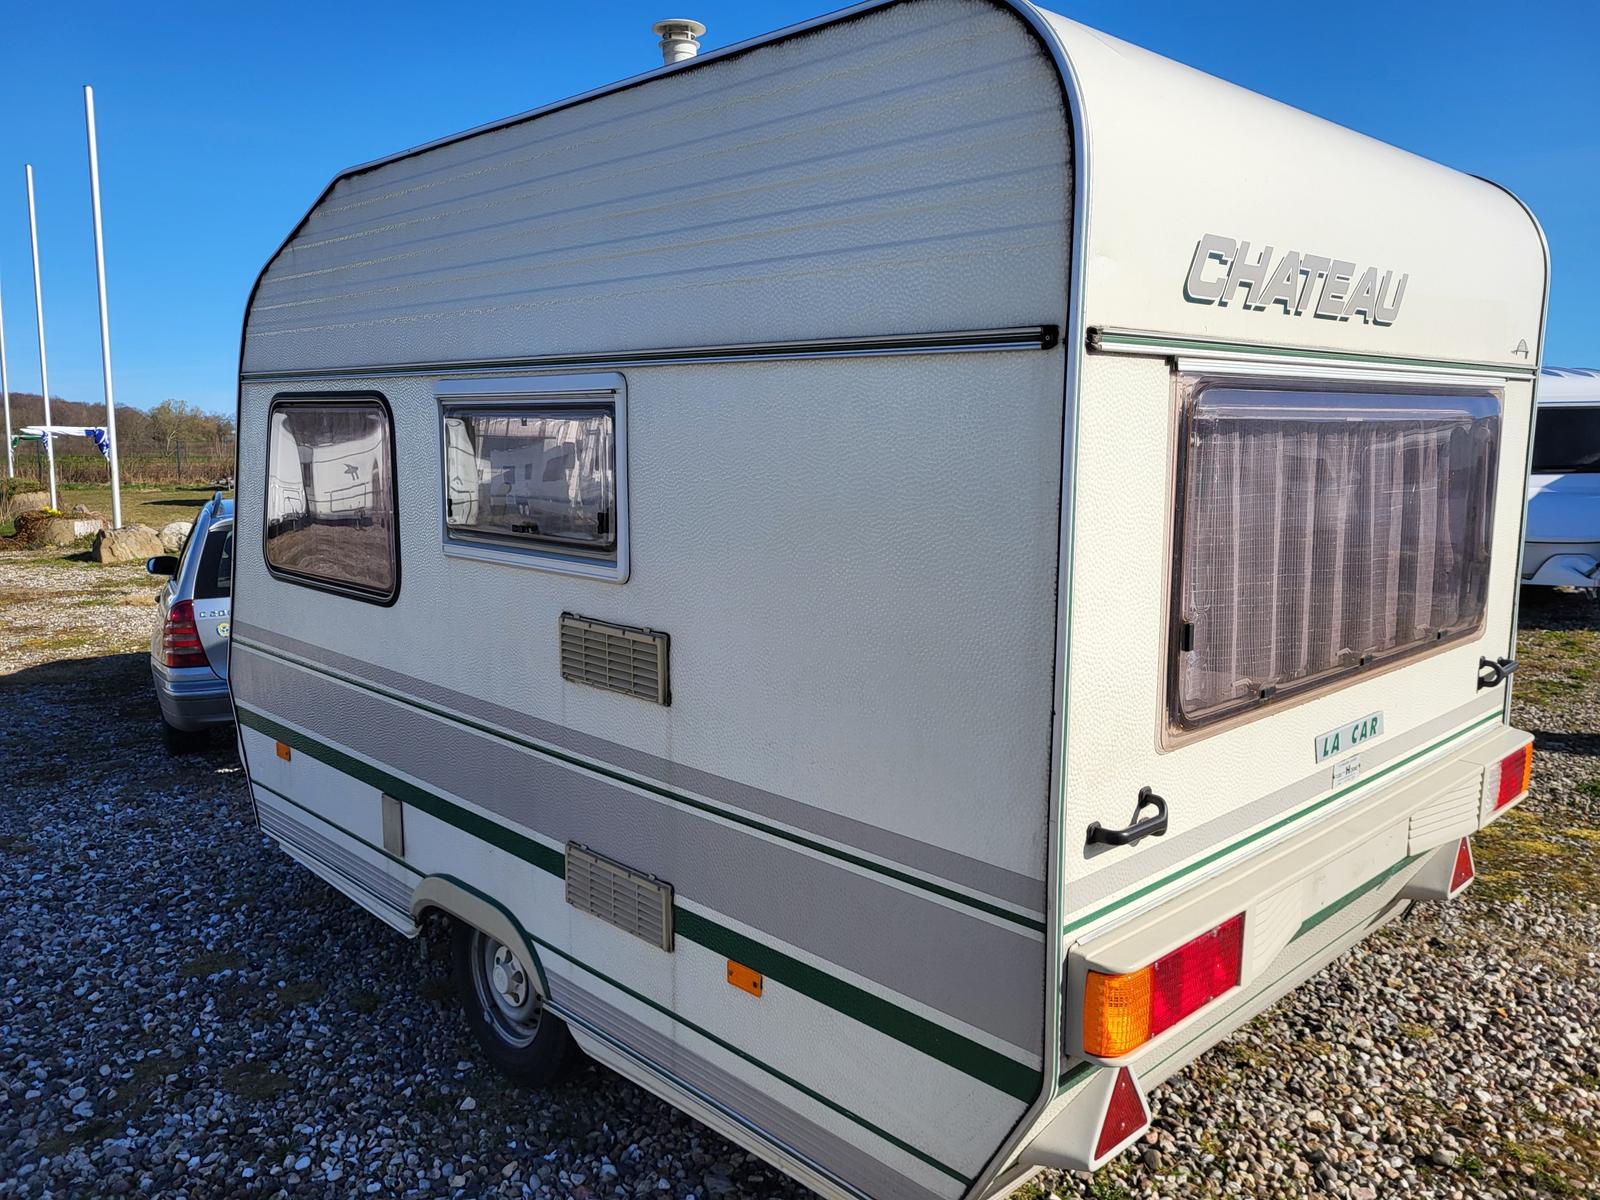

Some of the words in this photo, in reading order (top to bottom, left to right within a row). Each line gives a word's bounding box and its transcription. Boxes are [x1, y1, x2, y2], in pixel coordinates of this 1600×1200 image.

[1183, 233, 1409, 327] CHATEAU
[1323, 732, 1340, 757] LA
[1351, 716, 1378, 744] CAR
